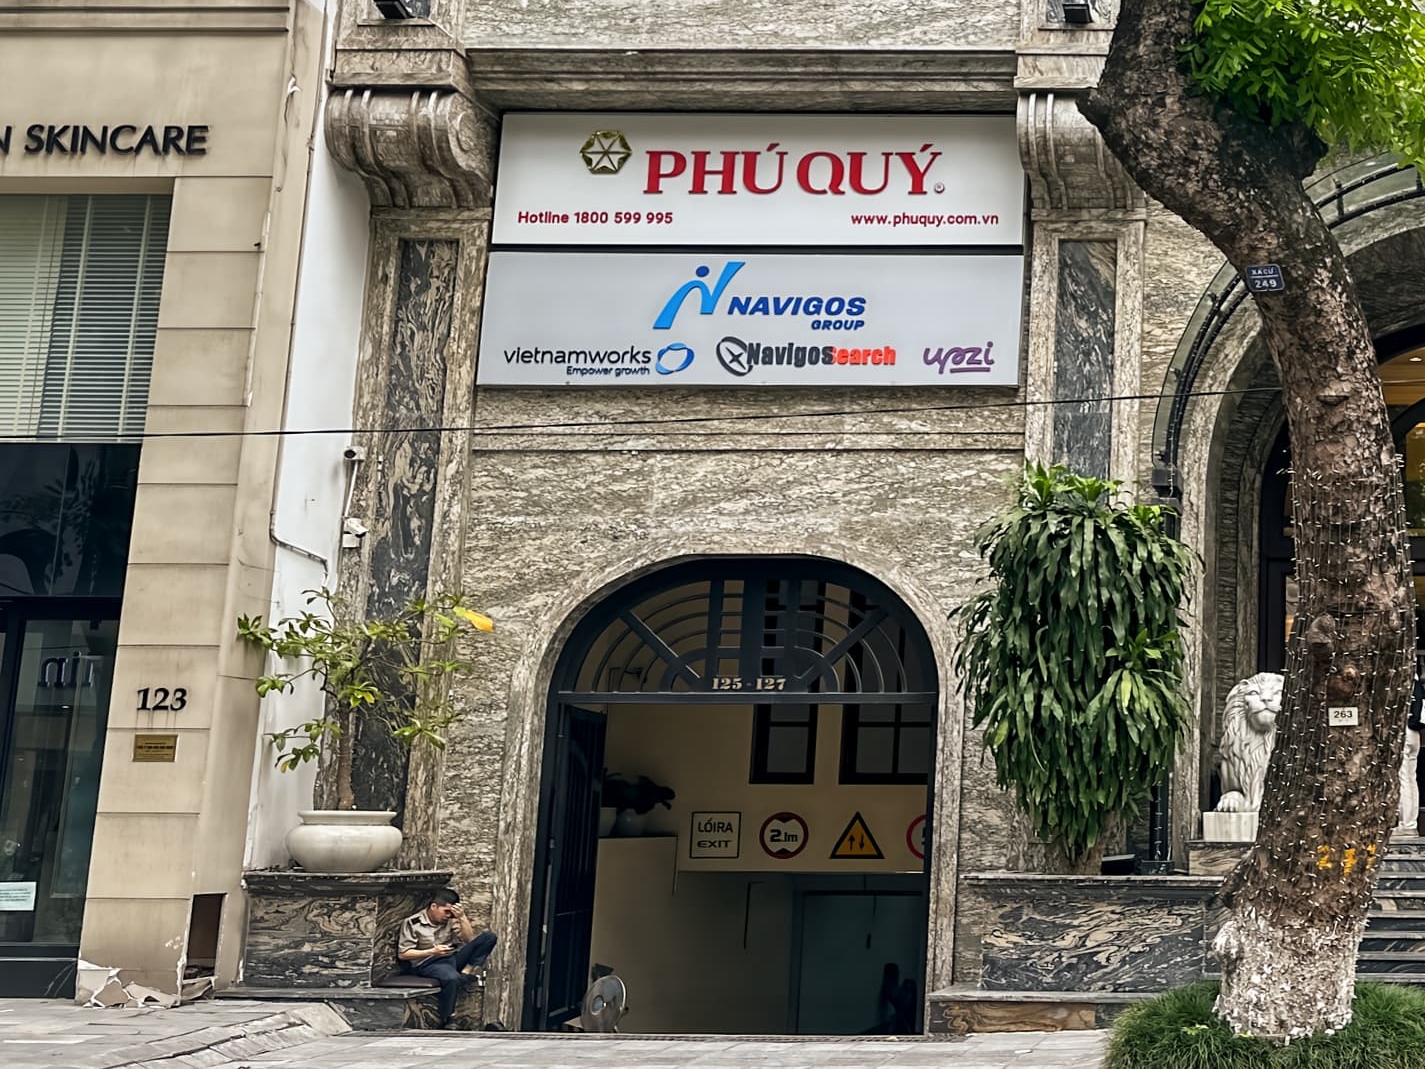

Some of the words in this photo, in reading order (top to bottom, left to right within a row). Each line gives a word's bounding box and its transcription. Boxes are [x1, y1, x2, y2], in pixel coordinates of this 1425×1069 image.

[24, 124, 210, 156] SKINCARE
[643, 142, 788, 195] PHÚ
[796, 143, 942, 195] QUÝ
[518, 211, 569, 224] Hotline
[574, 211, 608, 224] 1800
[614, 212, 641, 224] 599
[646, 212, 673, 224] 995
[851, 212, 999, 227] www.phuquy.com.vn
[727, 296, 866, 316] NAVIGOS
[811, 320, 865, 330] GROUP
[504, 346, 652, 365] vietnamworks
[567, 365, 612, 377] Empower
[615, 365, 650, 378] growth
[712, 677, 743, 690] 125
[756, 677, 786, 690] 127
[136, 687, 187, 711] 123
[1333, 710, 1353, 719] 263
[697, 840, 733, 849] EXIT
